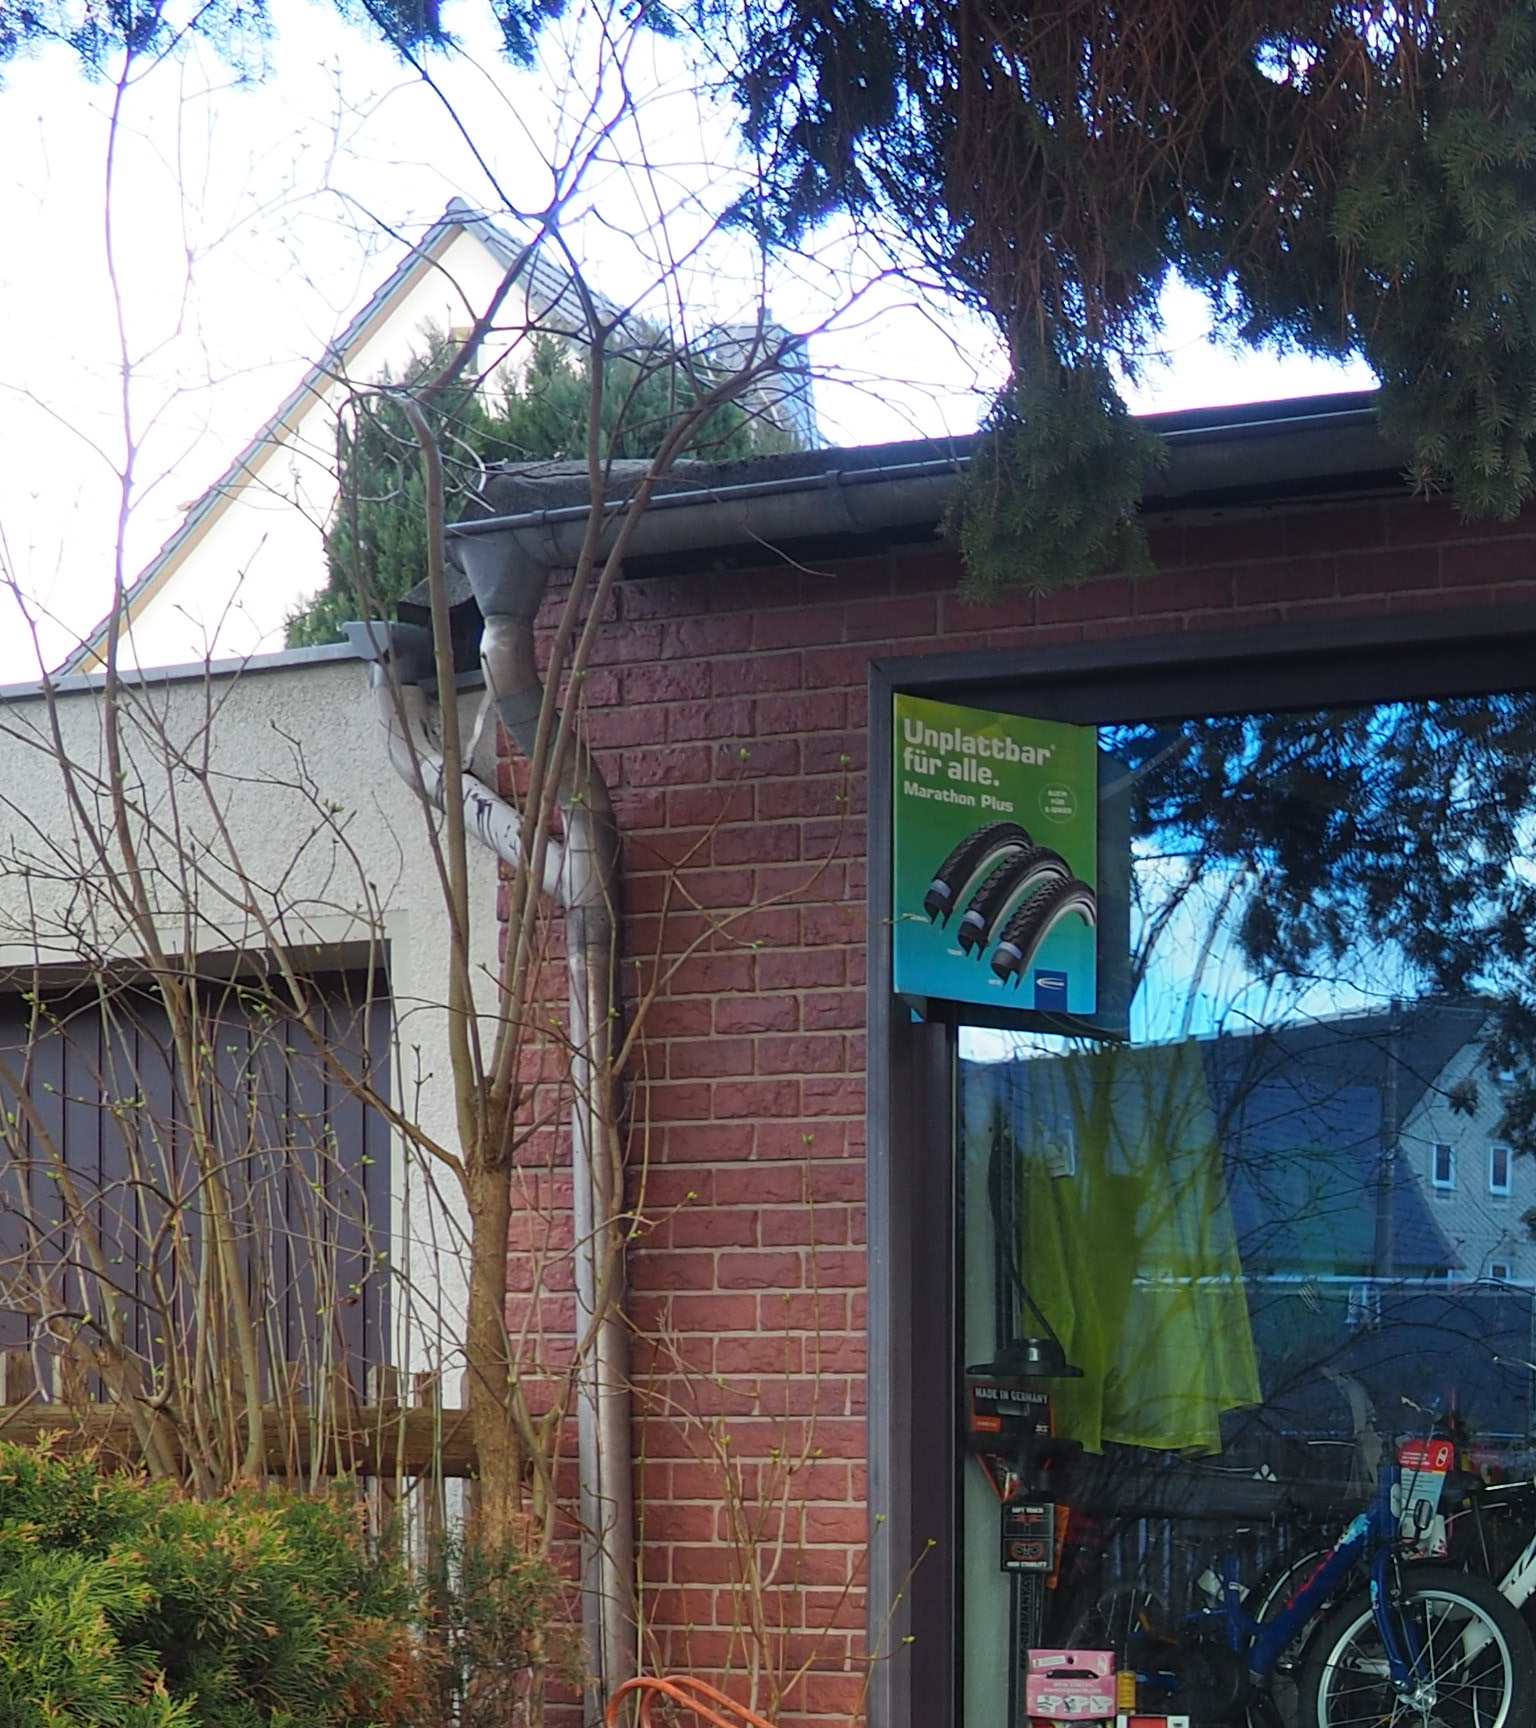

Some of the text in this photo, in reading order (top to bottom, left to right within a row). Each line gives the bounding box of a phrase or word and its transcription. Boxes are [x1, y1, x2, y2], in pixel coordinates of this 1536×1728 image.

[903, 747, 1000, 787] für alle.
[903, 781, 1014, 813] Marathon Plus
[975, 1387, 1049, 1405] MADE IN GERMANY
